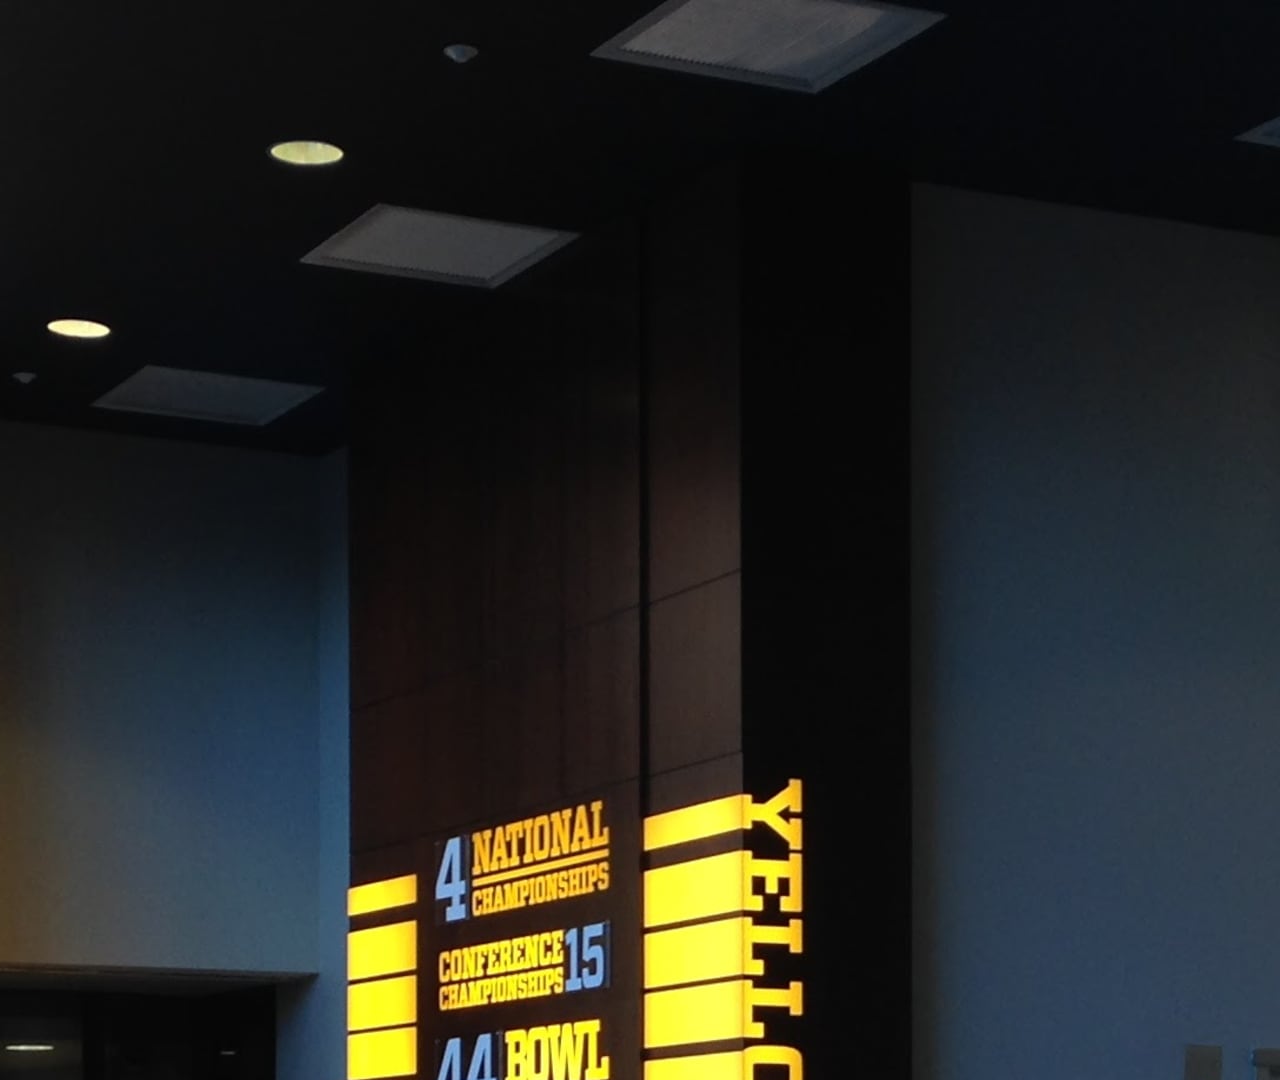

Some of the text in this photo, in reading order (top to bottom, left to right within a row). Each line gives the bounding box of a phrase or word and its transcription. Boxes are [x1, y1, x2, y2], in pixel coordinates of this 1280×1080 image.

[472, 801, 609, 875] NATIONAL
[435, 836, 466, 921] 4
[472, 862, 609, 916] CHAMPIONSHIPS
[439, 930, 564, 983] CONFERENCE
[565, 923, 604, 991] 15
[439, 967, 564, 1010] CHAMPIONSHIPS
